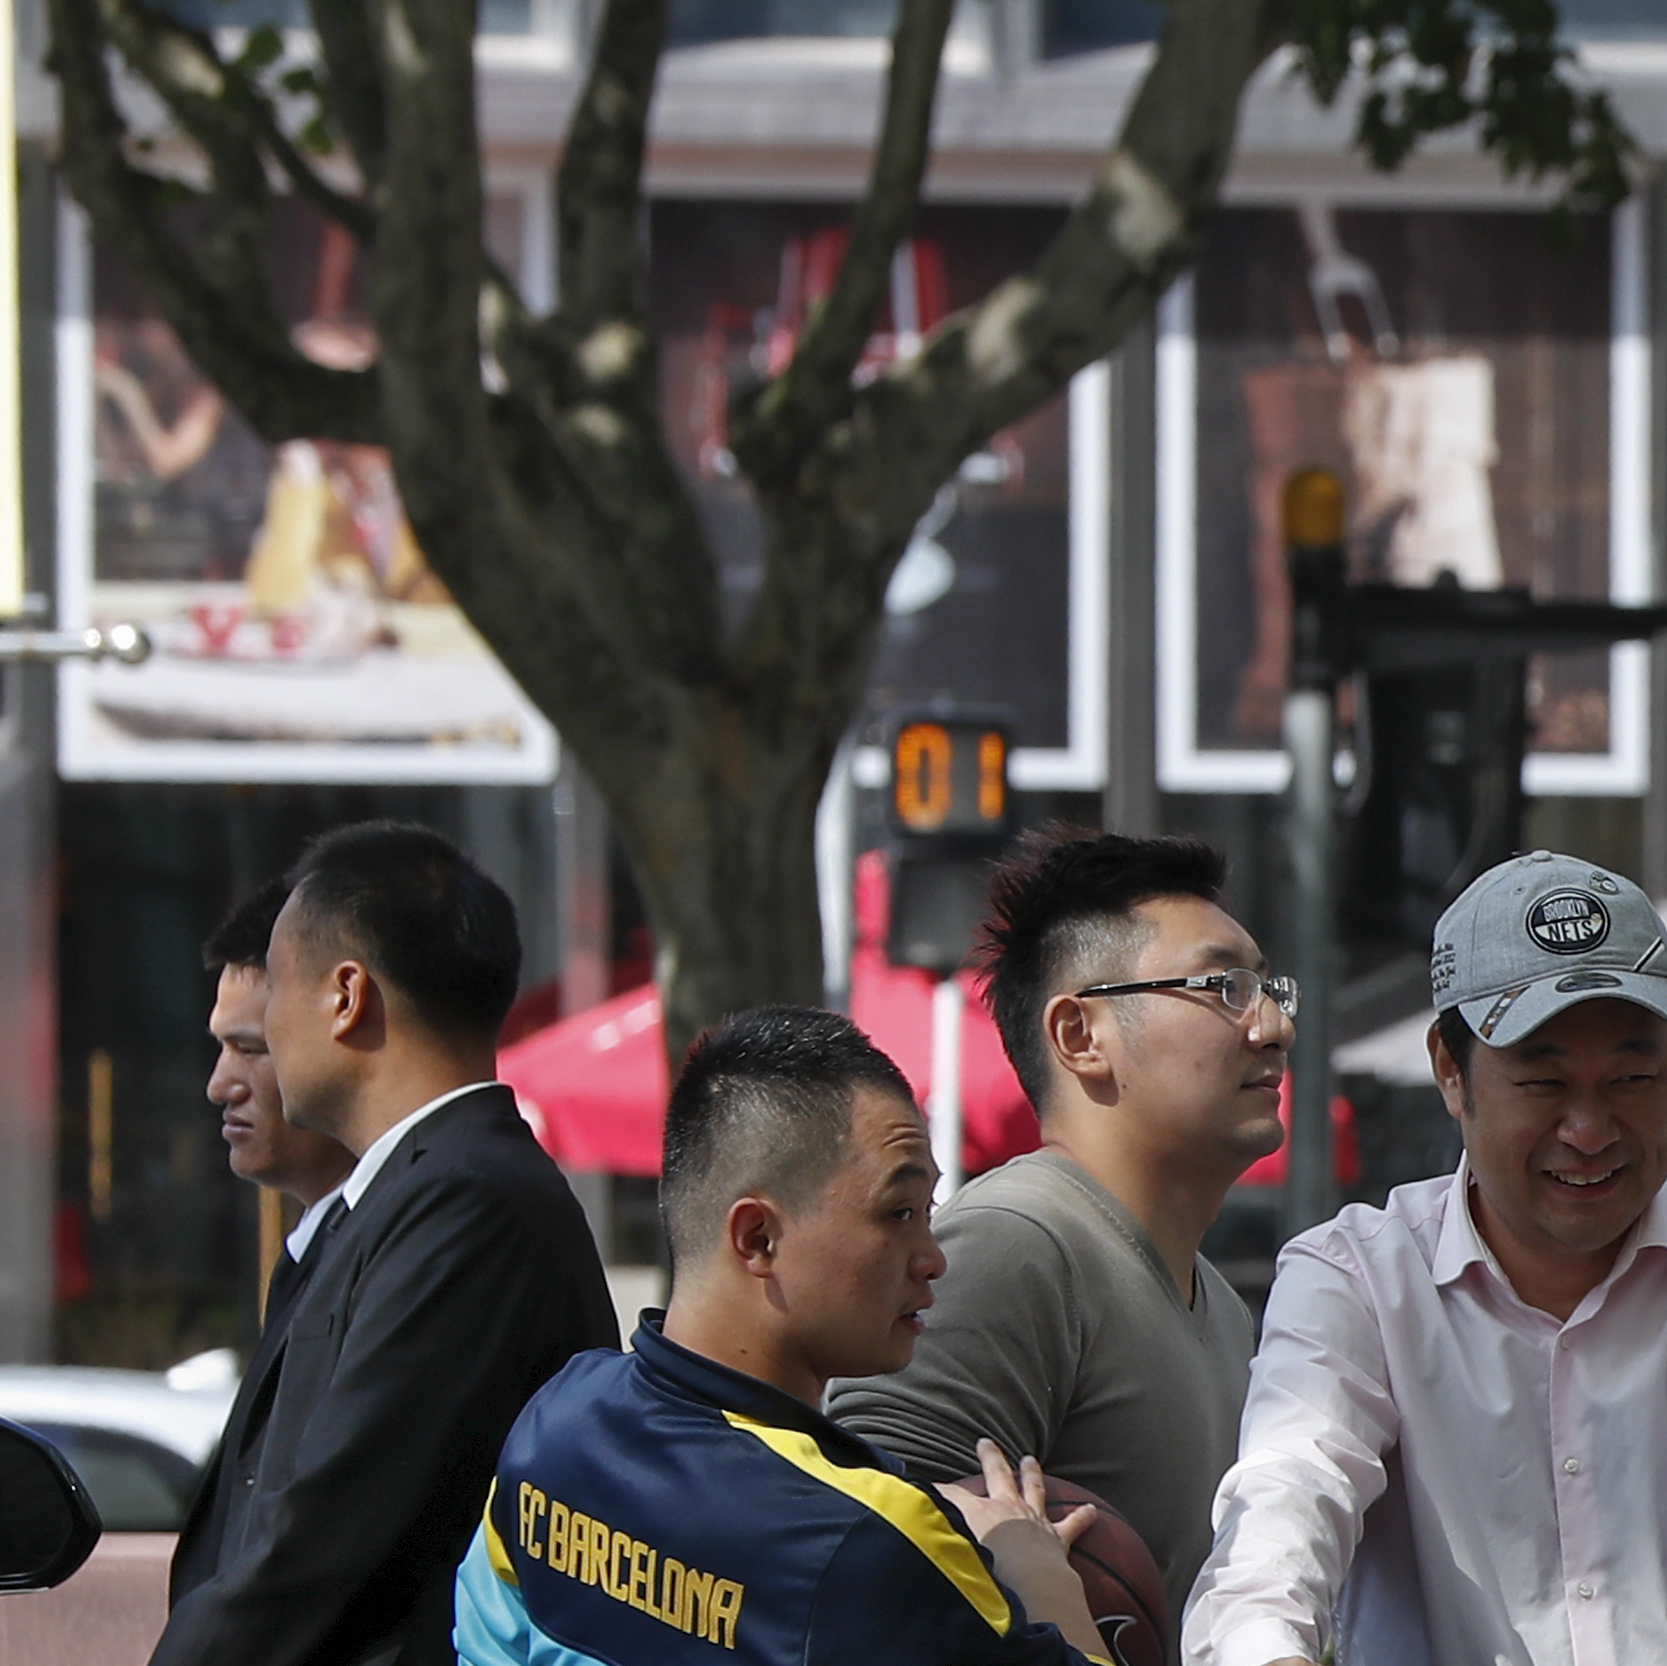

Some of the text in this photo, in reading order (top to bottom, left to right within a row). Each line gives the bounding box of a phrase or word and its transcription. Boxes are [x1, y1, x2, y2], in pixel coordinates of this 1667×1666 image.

[895, 722, 1006, 829] 01
[1542, 898, 1591, 920] BROOKLYN
[1548, 919, 1595, 943] NETS
[518, 1481, 746, 1650] FC BARCELONA
